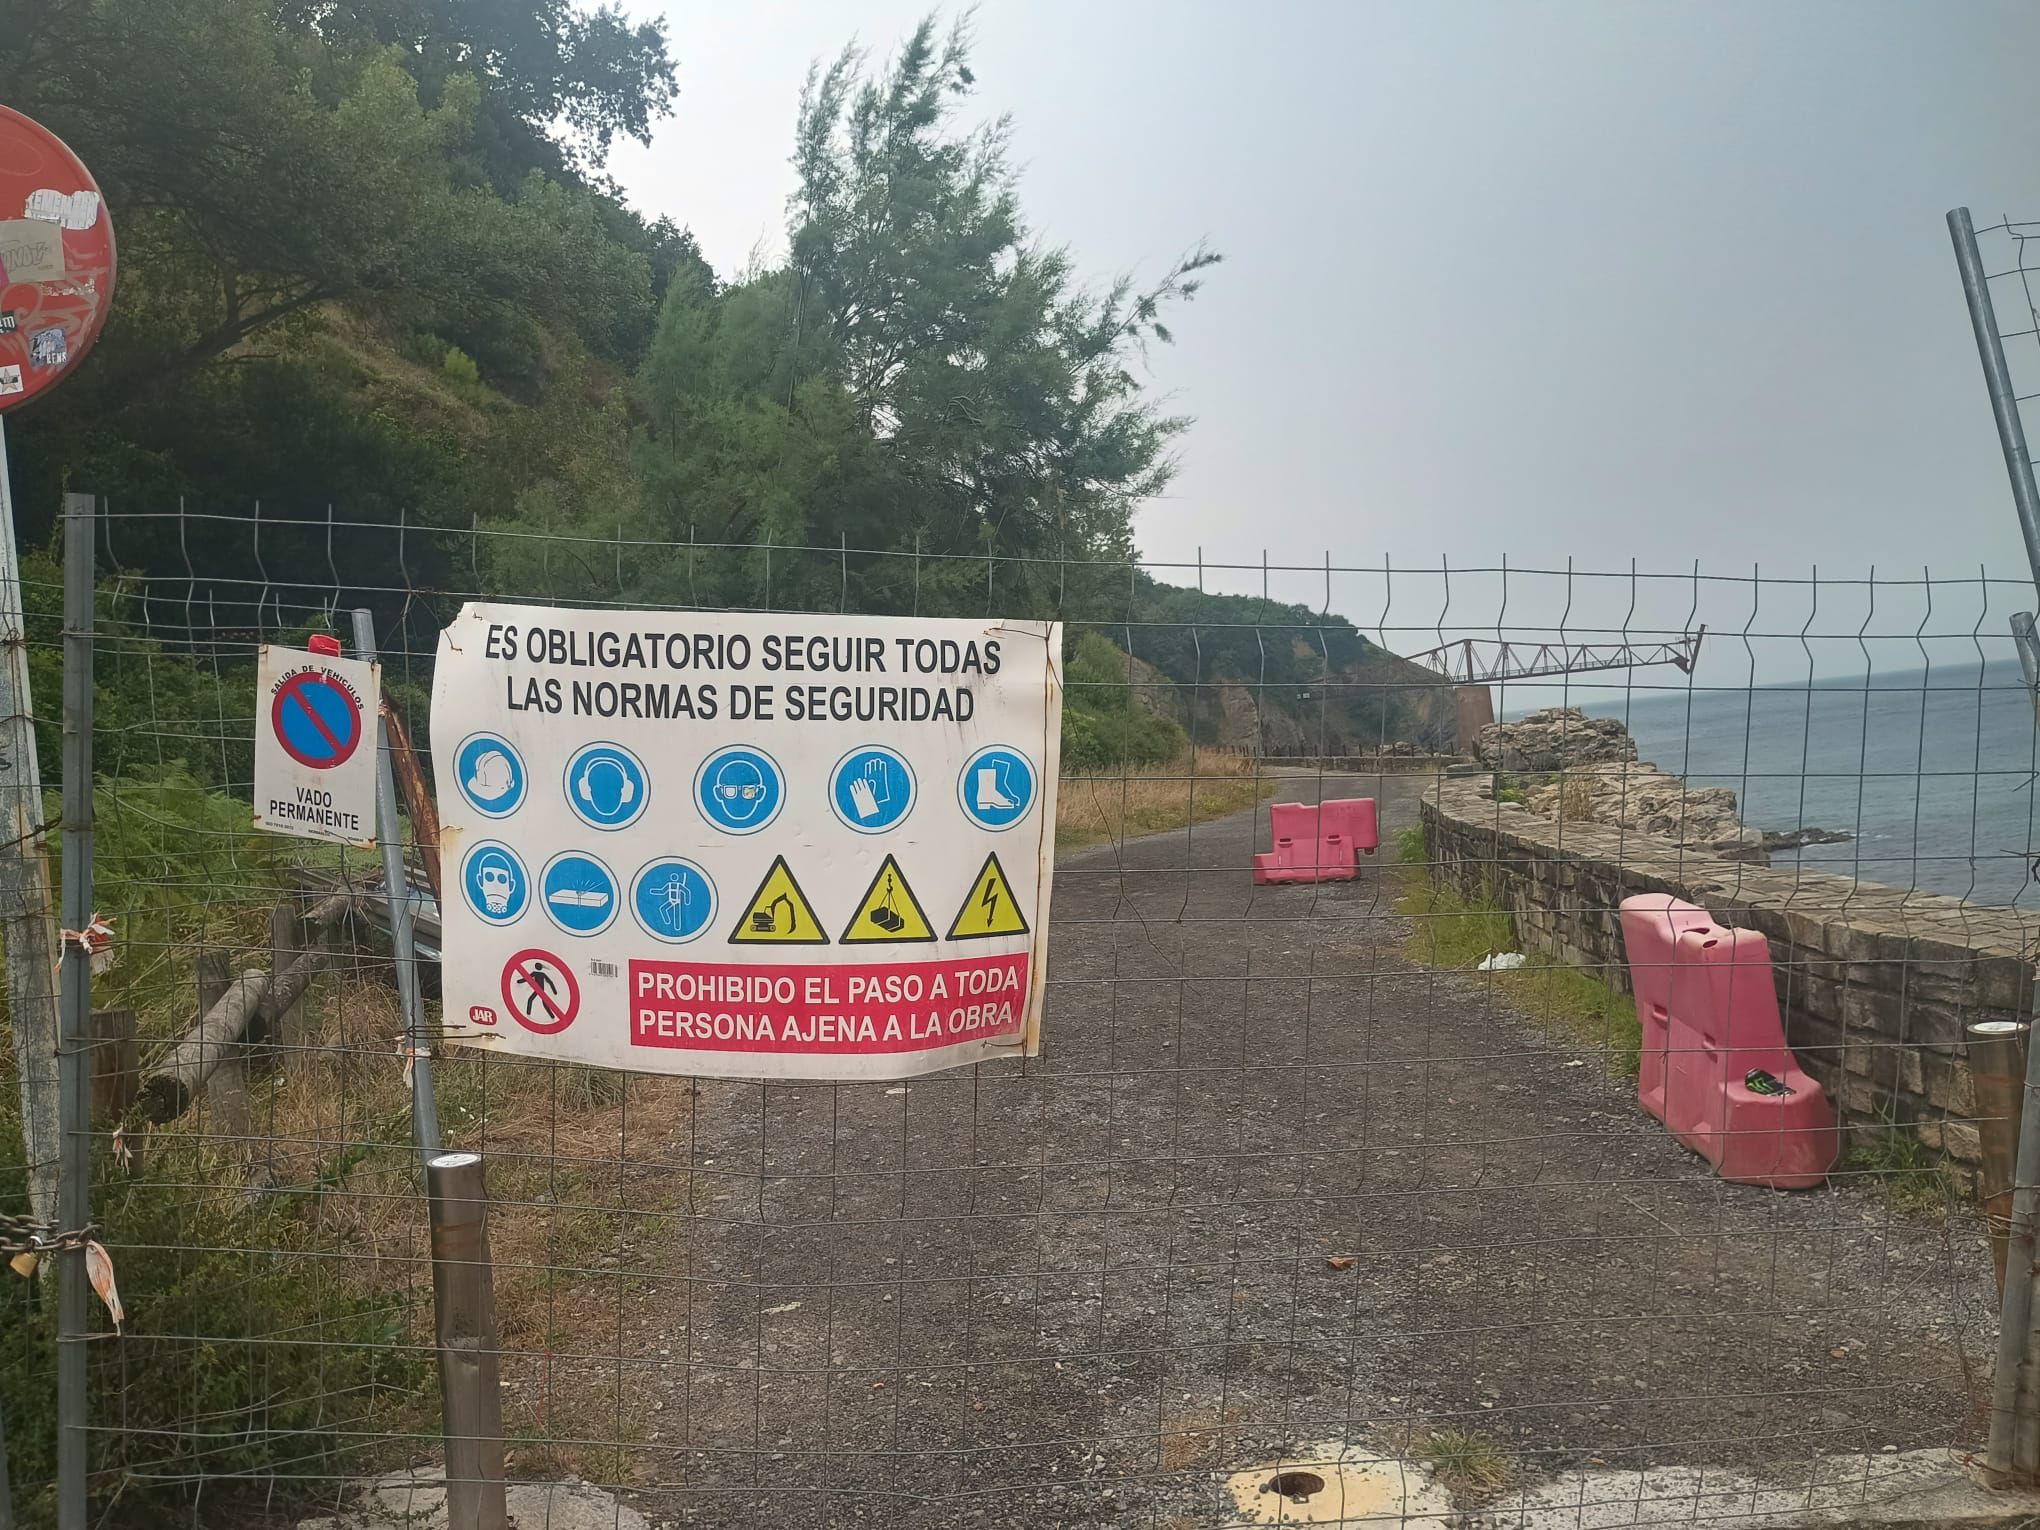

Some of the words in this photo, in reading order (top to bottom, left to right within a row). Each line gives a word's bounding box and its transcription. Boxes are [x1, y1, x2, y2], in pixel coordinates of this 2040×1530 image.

[485, 624, 518, 660] ES
[526, 627, 752, 670] OBLIGATORIO
[762, 635, 886, 673] SEGUIR
[895, 638, 1001, 674] TODAS
[271, 669, 297, 695] SALIDA
[321, 667, 364, 710] VEHICULOS
[507, 675, 562, 713] LAS
[573, 681, 718, 720] NORMAS
[730, 685, 774, 721] DE
[785, 685, 975, 722] SEGURIDAD
[270, 800, 359, 830] PERMANENTE
[296, 787, 332, 808] VADO
[638, 971, 795, 1004] PROHIBIDO
[804, 977, 840, 1003] EL
[848, 974, 923, 1003] PASO
[929, 973, 949, 999] A
[954, 966, 1019, 997] TODA
[473, 1008, 494, 1022] JAR
[638, 1009, 776, 1041] PERSONA
[781, 1015, 877, 1042] AJENA
[882, 1014, 903, 1041] A
[910, 1012, 942, 1039] LA
[948, 1001, 1013, 1034] OBRA
